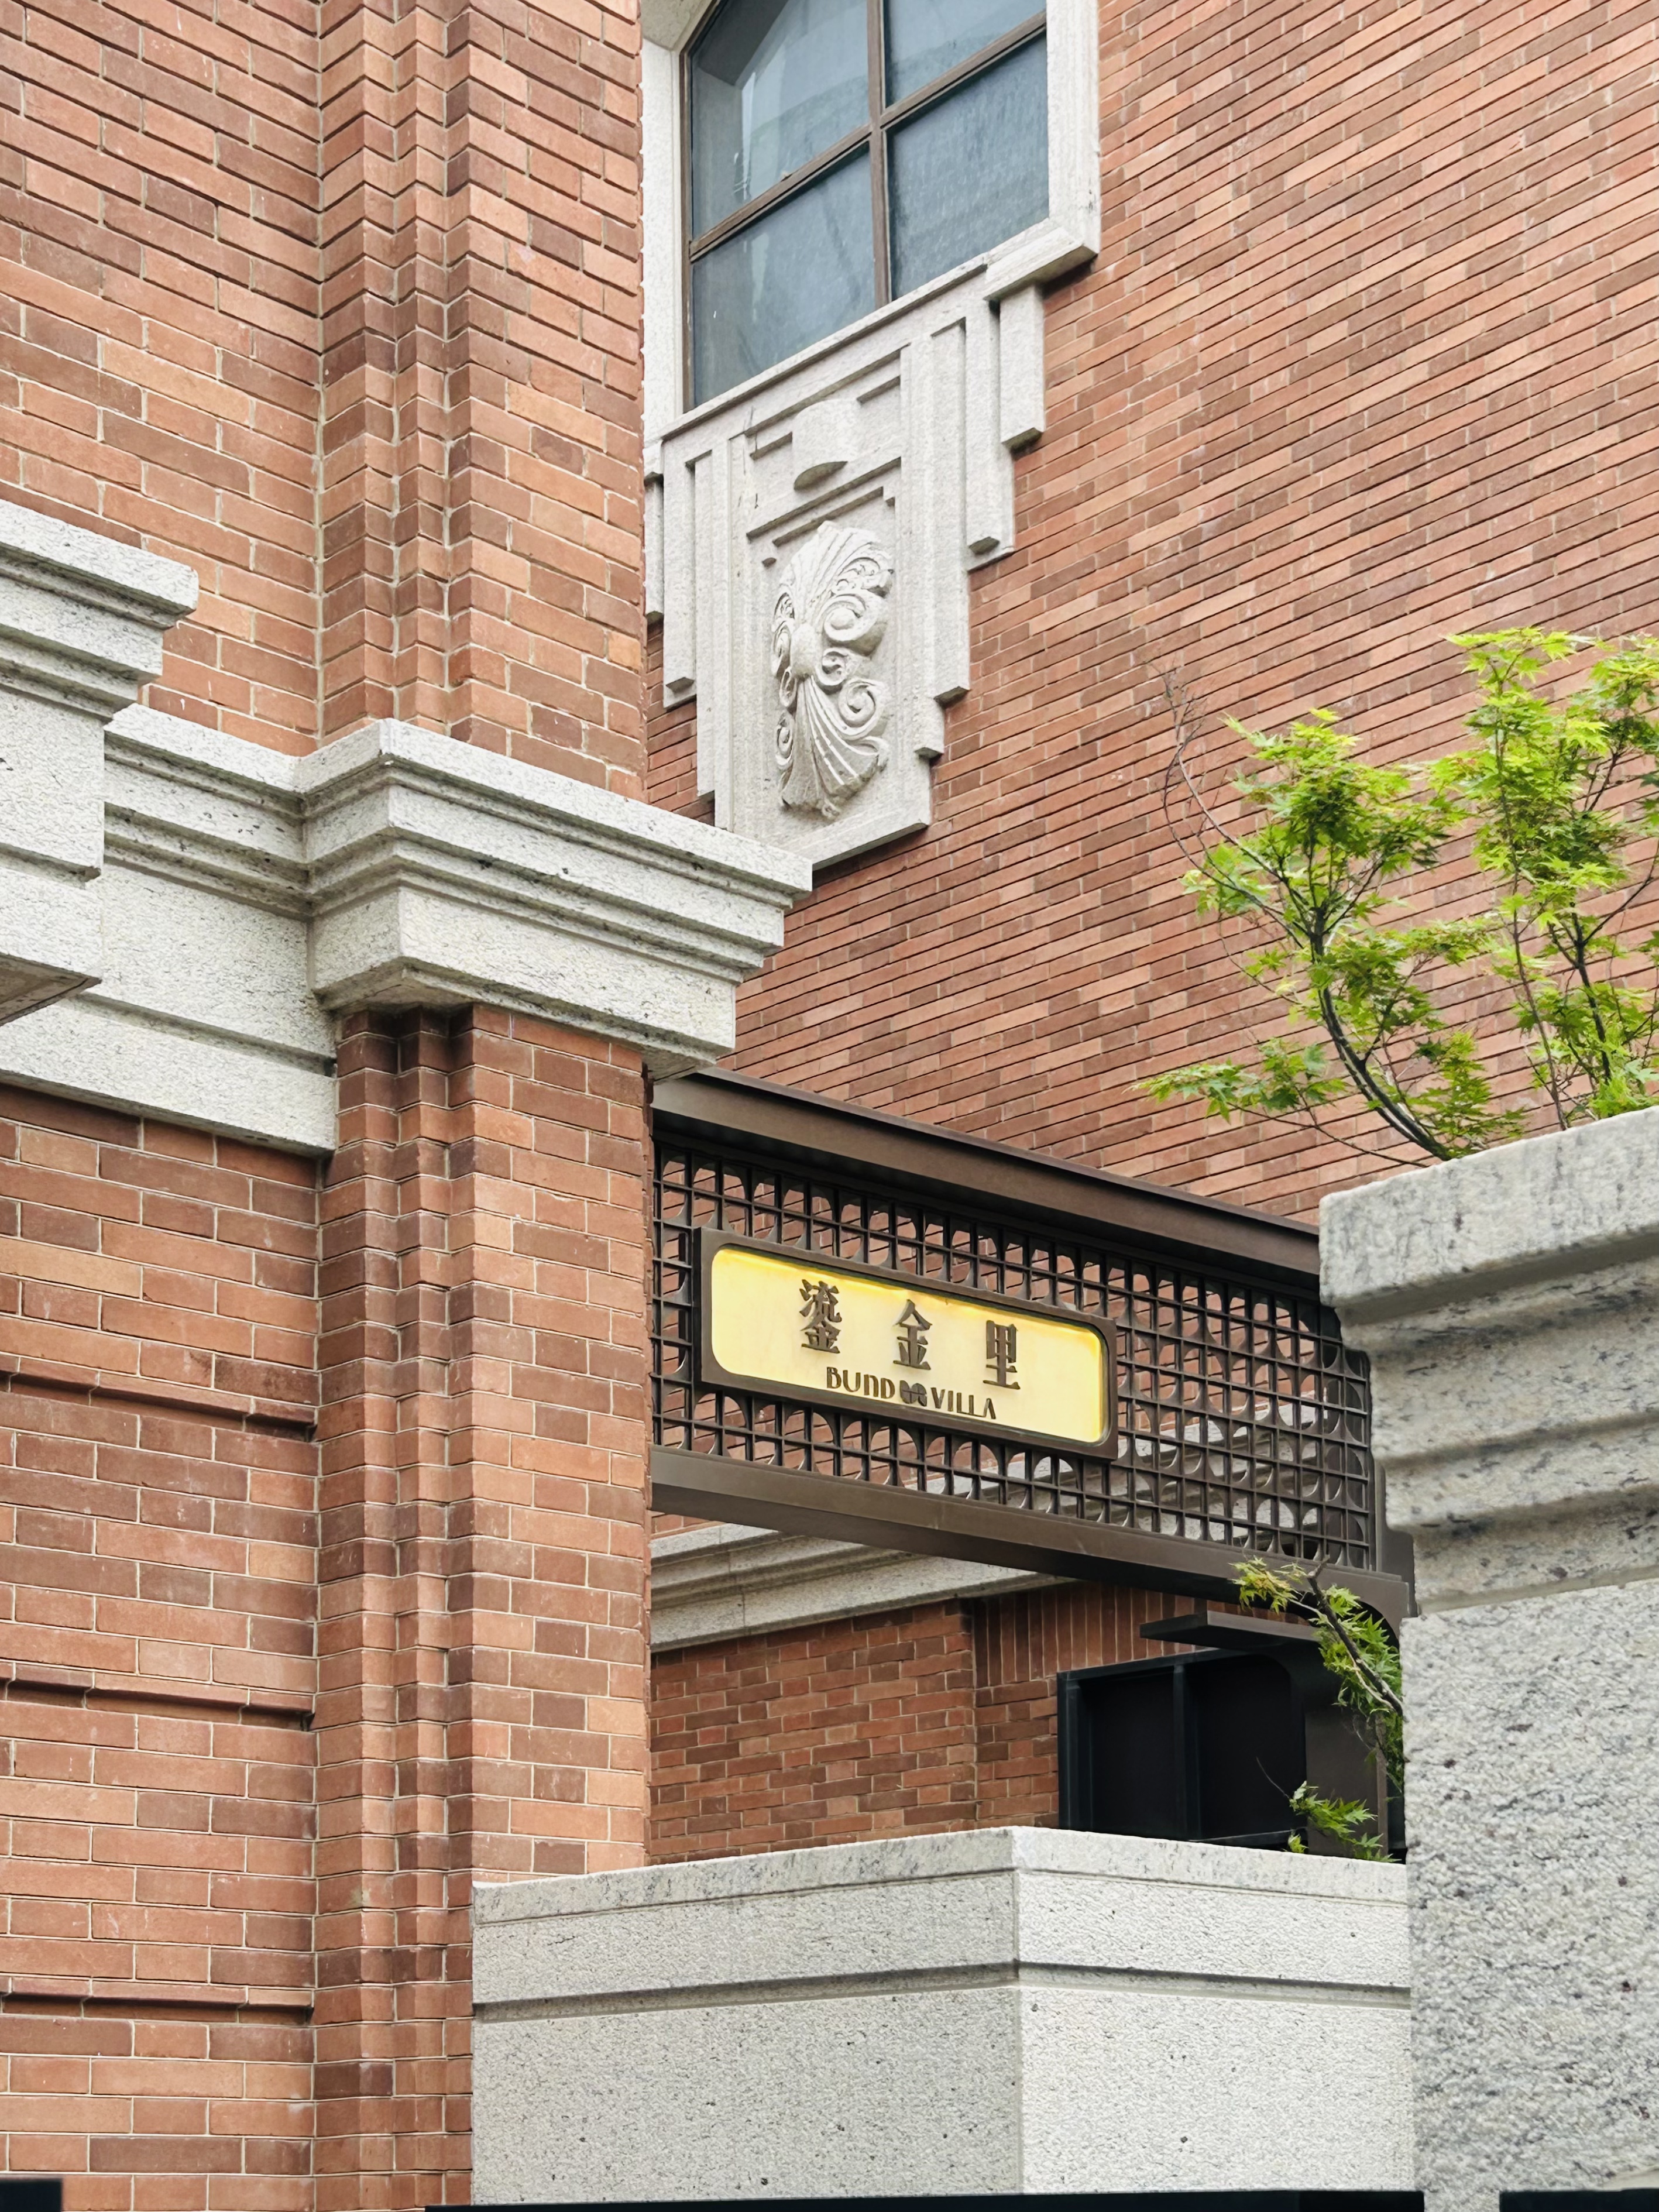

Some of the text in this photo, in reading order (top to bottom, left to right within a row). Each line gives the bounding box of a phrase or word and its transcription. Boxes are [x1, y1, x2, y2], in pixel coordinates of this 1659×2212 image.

[799, 1279, 1020, 1389] 鎏金里
[826, 1366, 997, 1420] BUND VILLA
